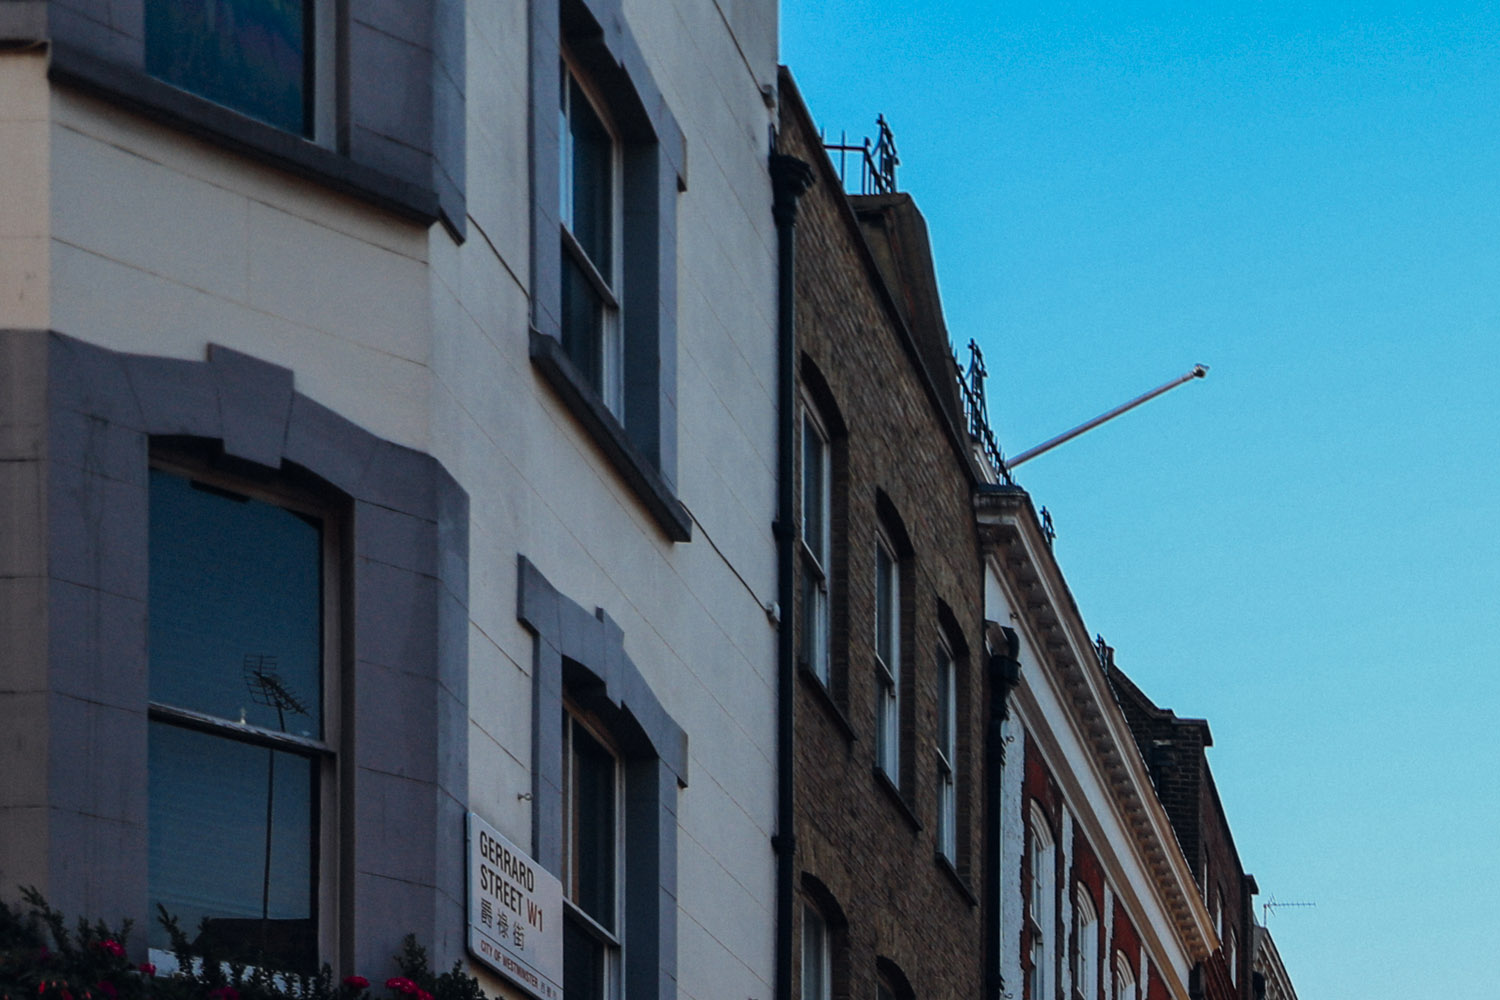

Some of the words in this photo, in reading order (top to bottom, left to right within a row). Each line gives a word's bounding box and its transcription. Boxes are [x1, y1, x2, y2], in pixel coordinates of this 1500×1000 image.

[479, 831, 534, 893] GERRARD
[480, 864, 523, 916] STREET
[527, 898, 543, 932] W1
[481, 940, 493, 957] CITY
[494, 948, 502, 962] OF
[502, 956, 539, 991] WESTMINSTER
